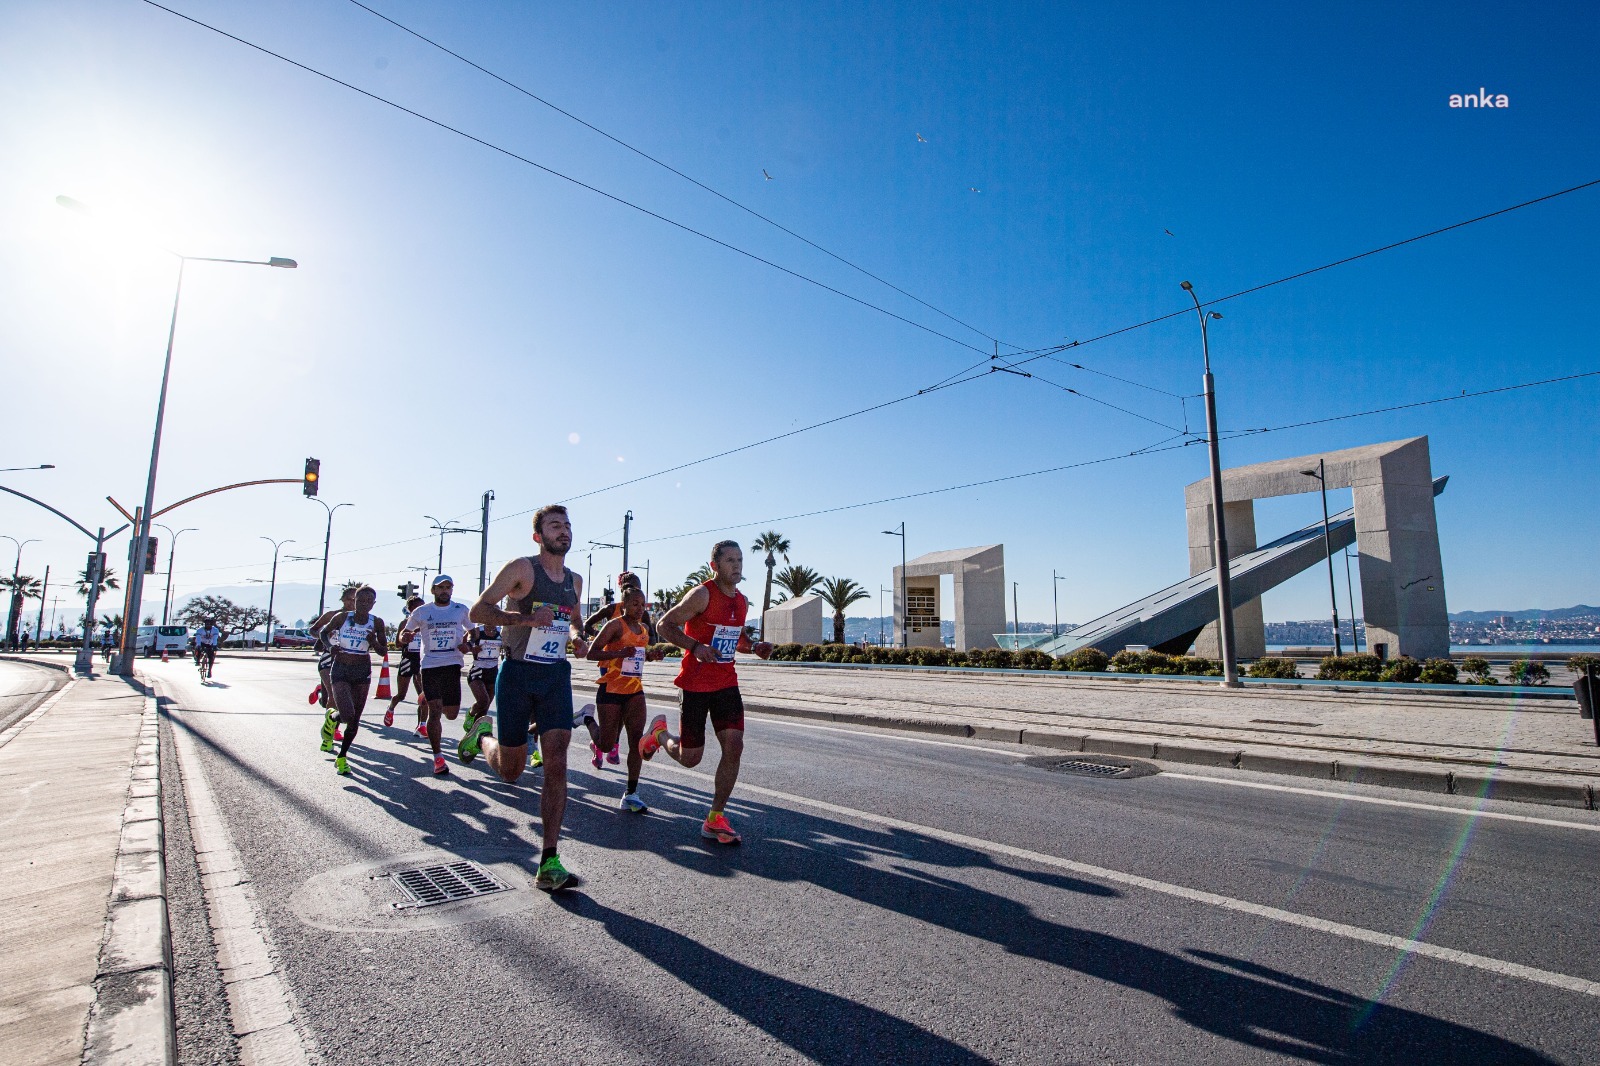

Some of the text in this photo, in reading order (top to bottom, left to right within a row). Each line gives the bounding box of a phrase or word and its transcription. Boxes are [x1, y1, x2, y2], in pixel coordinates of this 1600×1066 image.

[350, 639, 361, 648] 17
[437, 639, 449, 648] 27
[541, 641, 560, 654] 42
[717, 639, 738, 655] 1245
[634, 661, 641, 671] 3
